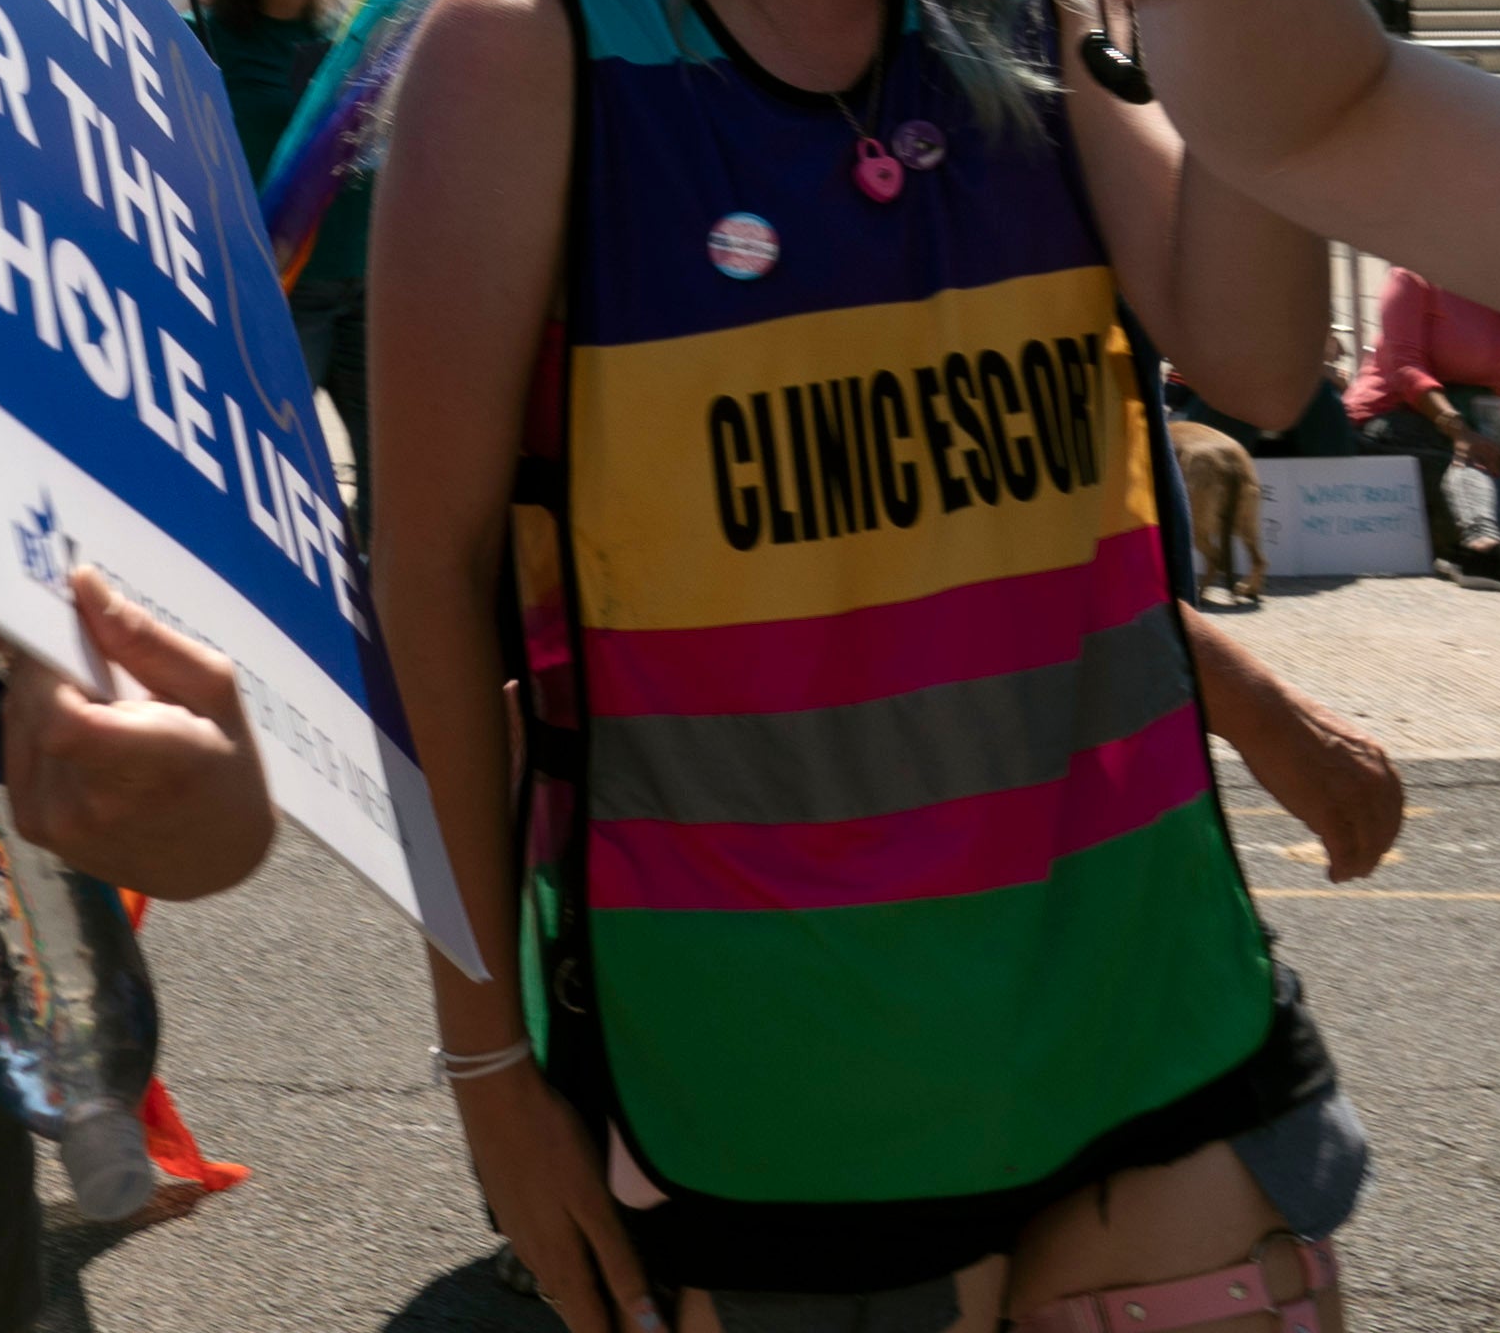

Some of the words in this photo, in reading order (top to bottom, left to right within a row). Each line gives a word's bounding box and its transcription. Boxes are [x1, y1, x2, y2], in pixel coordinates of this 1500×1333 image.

[48, 58, 216, 326] THE
[224, 393, 371, 643] LIFE
[709, 369, 922, 552] CLINIC
